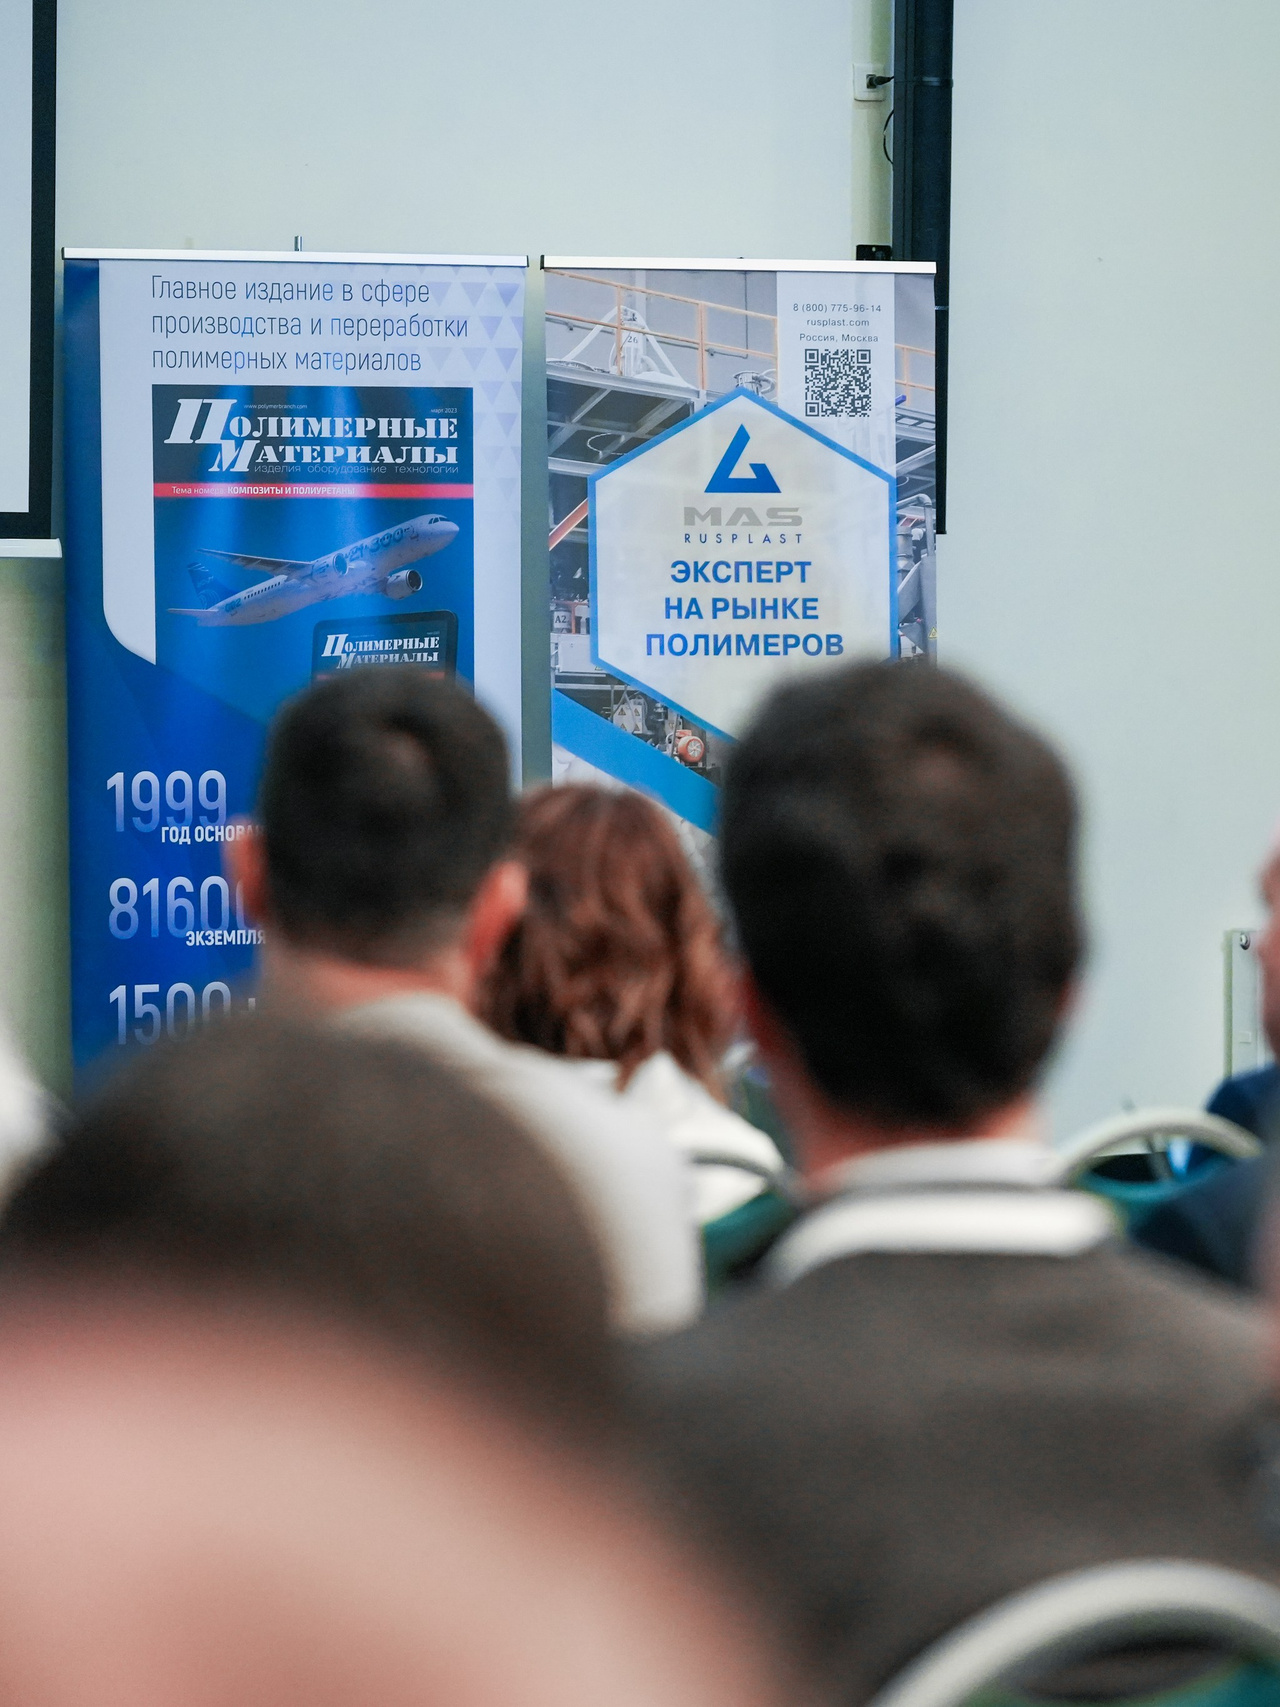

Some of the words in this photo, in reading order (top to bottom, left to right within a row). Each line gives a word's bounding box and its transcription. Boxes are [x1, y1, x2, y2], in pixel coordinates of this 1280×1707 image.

[152, 275, 237, 300] Главное
[245, 282, 333, 303] издание
[342, 283, 353, 301] в
[362, 278, 430, 307] сфере
[792, 303, 799, 312] 8
[802, 303, 828, 313] (800)
[831, 303, 882, 312] 775-96-14
[152, 315, 301, 339] производства
[311, 318, 322, 335] и
[331, 313, 468, 341] переработки
[806, 318, 870, 327] rusplast.com
[799, 333, 839, 343] Россия,
[841, 333, 879, 342] Москва
[152, 350, 288, 374] полимерных
[295, 352, 421, 375] материалов
[254, 465, 301, 474] изделия
[307, 464, 387, 475] оборудование
[395, 465, 459, 474] технологии
[171, 485, 192, 495] Тема
[227, 486, 284, 495] КОМПОЗИТЫ
[285, 486, 292, 495] И
[293, 486, 355, 495] ПОЛИУРЕТАНЫ
[683, 506, 803, 527] MAS
[684, 533, 803, 544] RUSPLAST
[670, 560, 812, 583] ЭКСПЕРТ
[664, 597, 703, 619] НА
[711, 597, 819, 620] РЫНКЕ
[646, 633, 844, 656] ПОЛИМЕРОВ
[106, 769, 227, 833] 1999
[161, 826, 191, 845] ГОД
